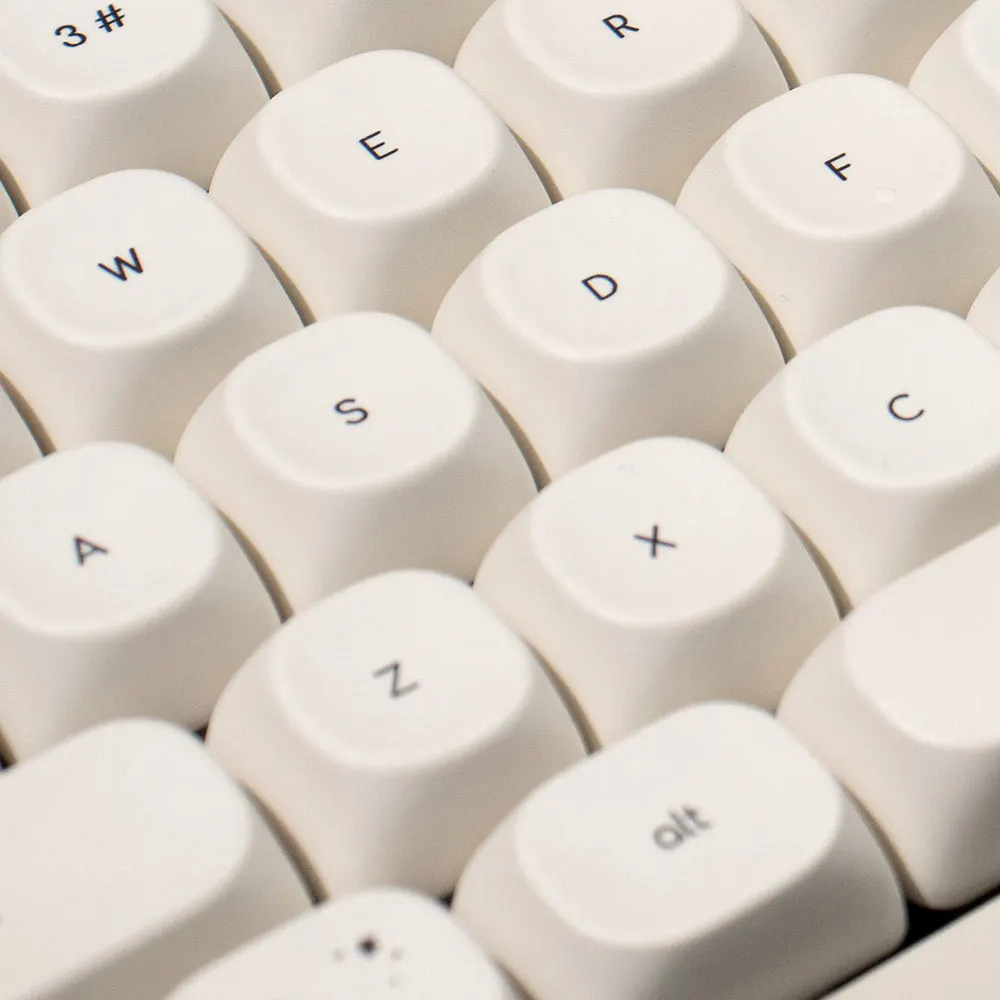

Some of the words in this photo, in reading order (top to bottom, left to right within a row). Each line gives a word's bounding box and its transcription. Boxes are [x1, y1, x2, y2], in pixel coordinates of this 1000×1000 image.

[601, 14, 640, 39] R
[358, 130, 399, 161] E
[823, 152, 852, 182] F
[97, 247, 144, 282] W
[581, 273, 619, 302] D
[333, 397, 369, 425] S
[887, 393, 926, 422] C
[73, 535, 109, 566] A
[634, 524, 677, 558] X
[374, 661, 418, 699] Z
[652, 806, 711, 851] alt
